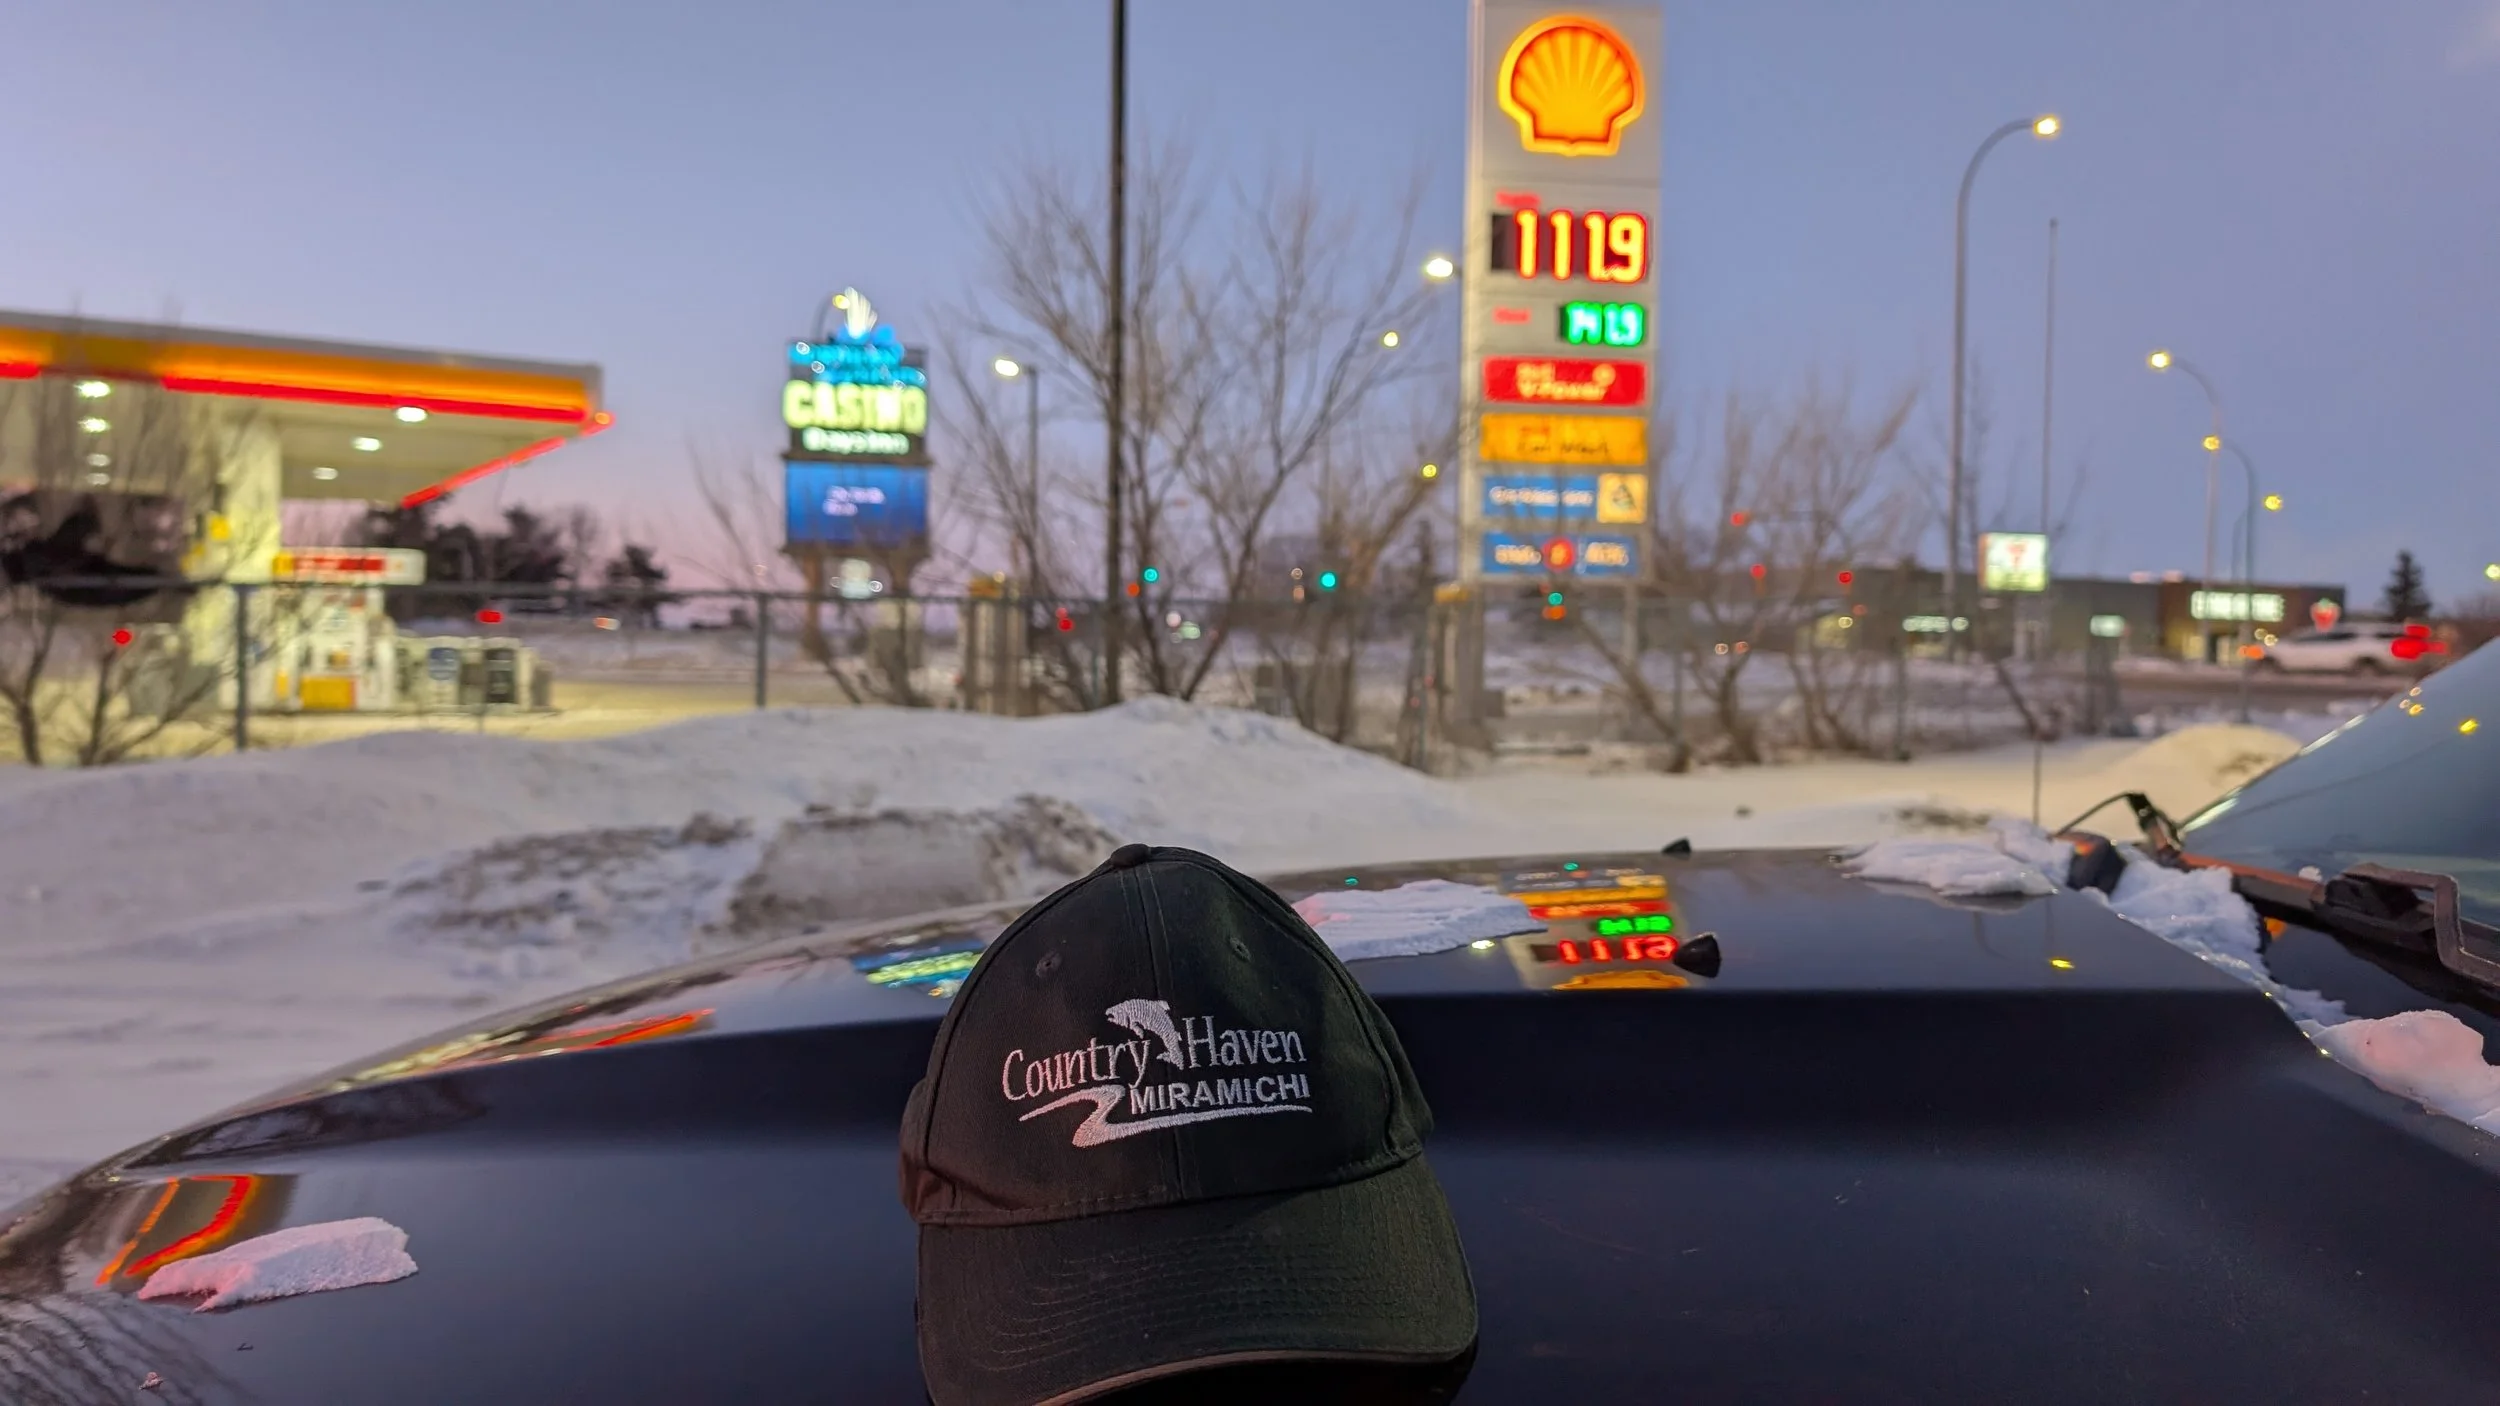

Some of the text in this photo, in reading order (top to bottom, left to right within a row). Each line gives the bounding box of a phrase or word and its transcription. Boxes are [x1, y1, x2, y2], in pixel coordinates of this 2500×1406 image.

[1002, 1015, 1307, 1101] Country Haven
[1128, 1073, 1311, 1115] MIRAMICHI
